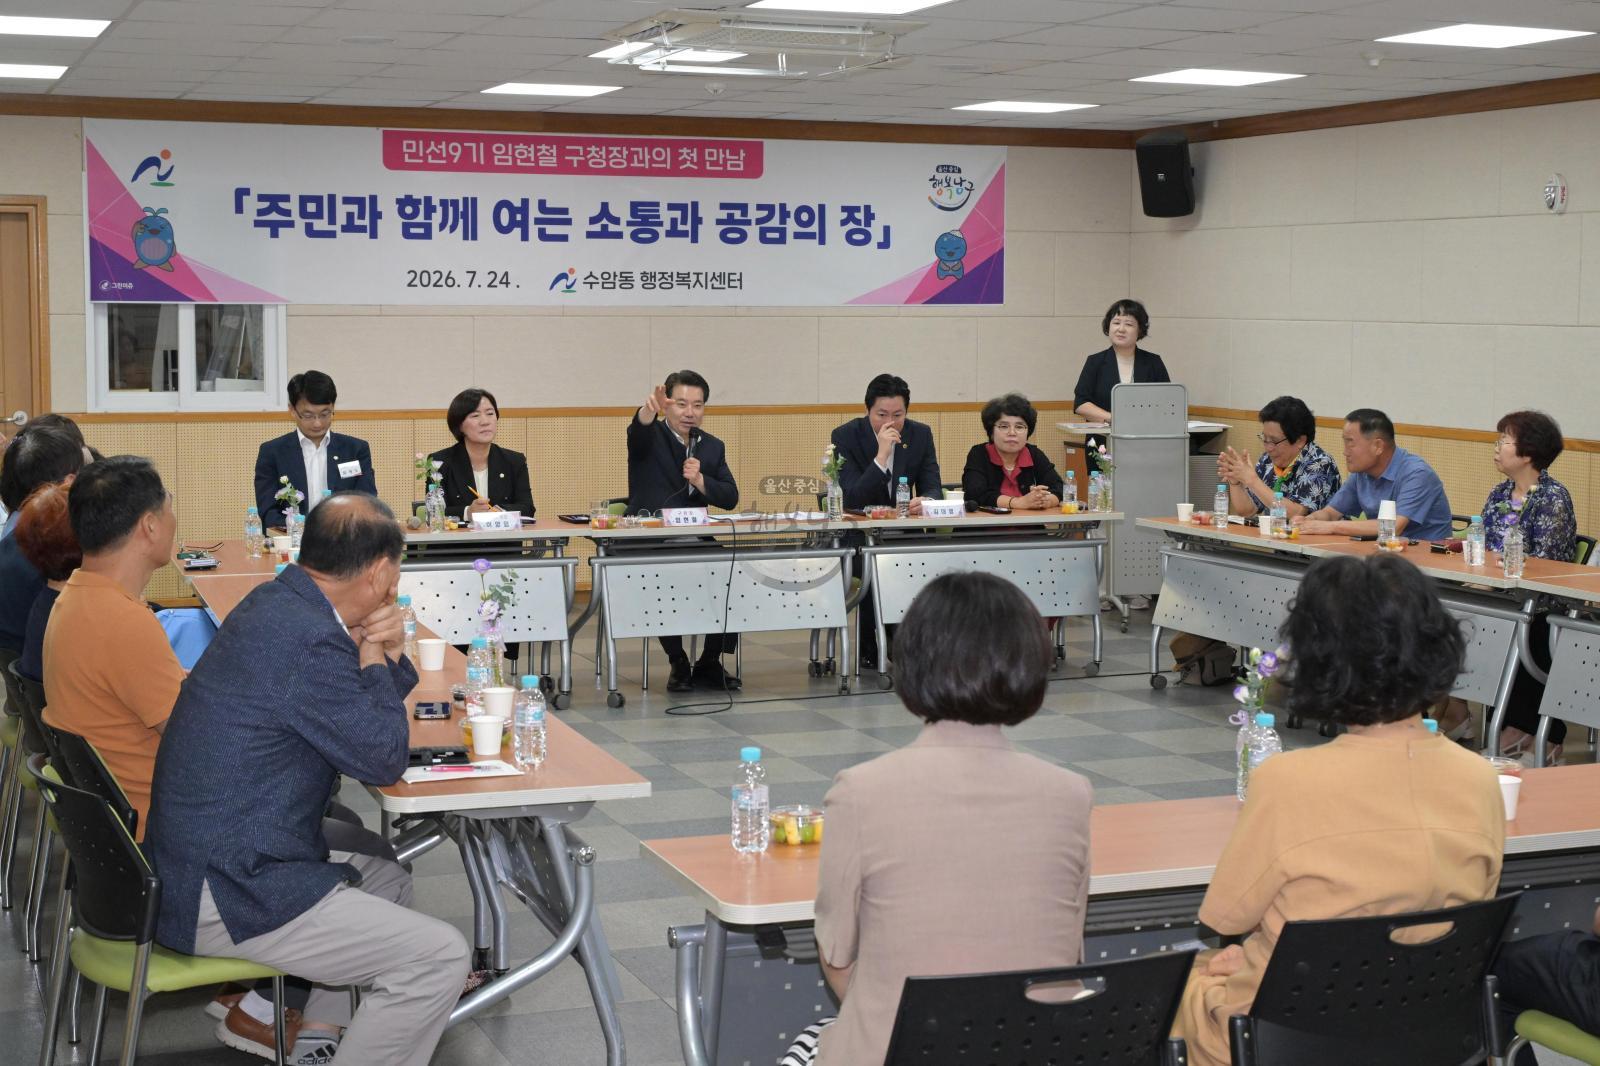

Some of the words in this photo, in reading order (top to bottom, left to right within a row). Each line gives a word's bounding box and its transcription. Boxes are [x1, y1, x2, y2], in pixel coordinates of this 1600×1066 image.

[402, 140, 485, 165] 민선9기
[492, 143, 558, 167] 임현철
[564, 145, 671, 169] 구청장과의
[678, 147, 698, 170] 첫
[704, 148, 746, 171] 만남
[395, 194, 479, 241] 함께
[492, 198, 573, 243] 여는
[585, 201, 704, 245] 소통과
[715, 202, 826, 246] 공감의
[582, 271, 636, 290] 수암동
[640, 271, 743, 290] 행정복지센터
[297, 1056, 332, 1066] adid
